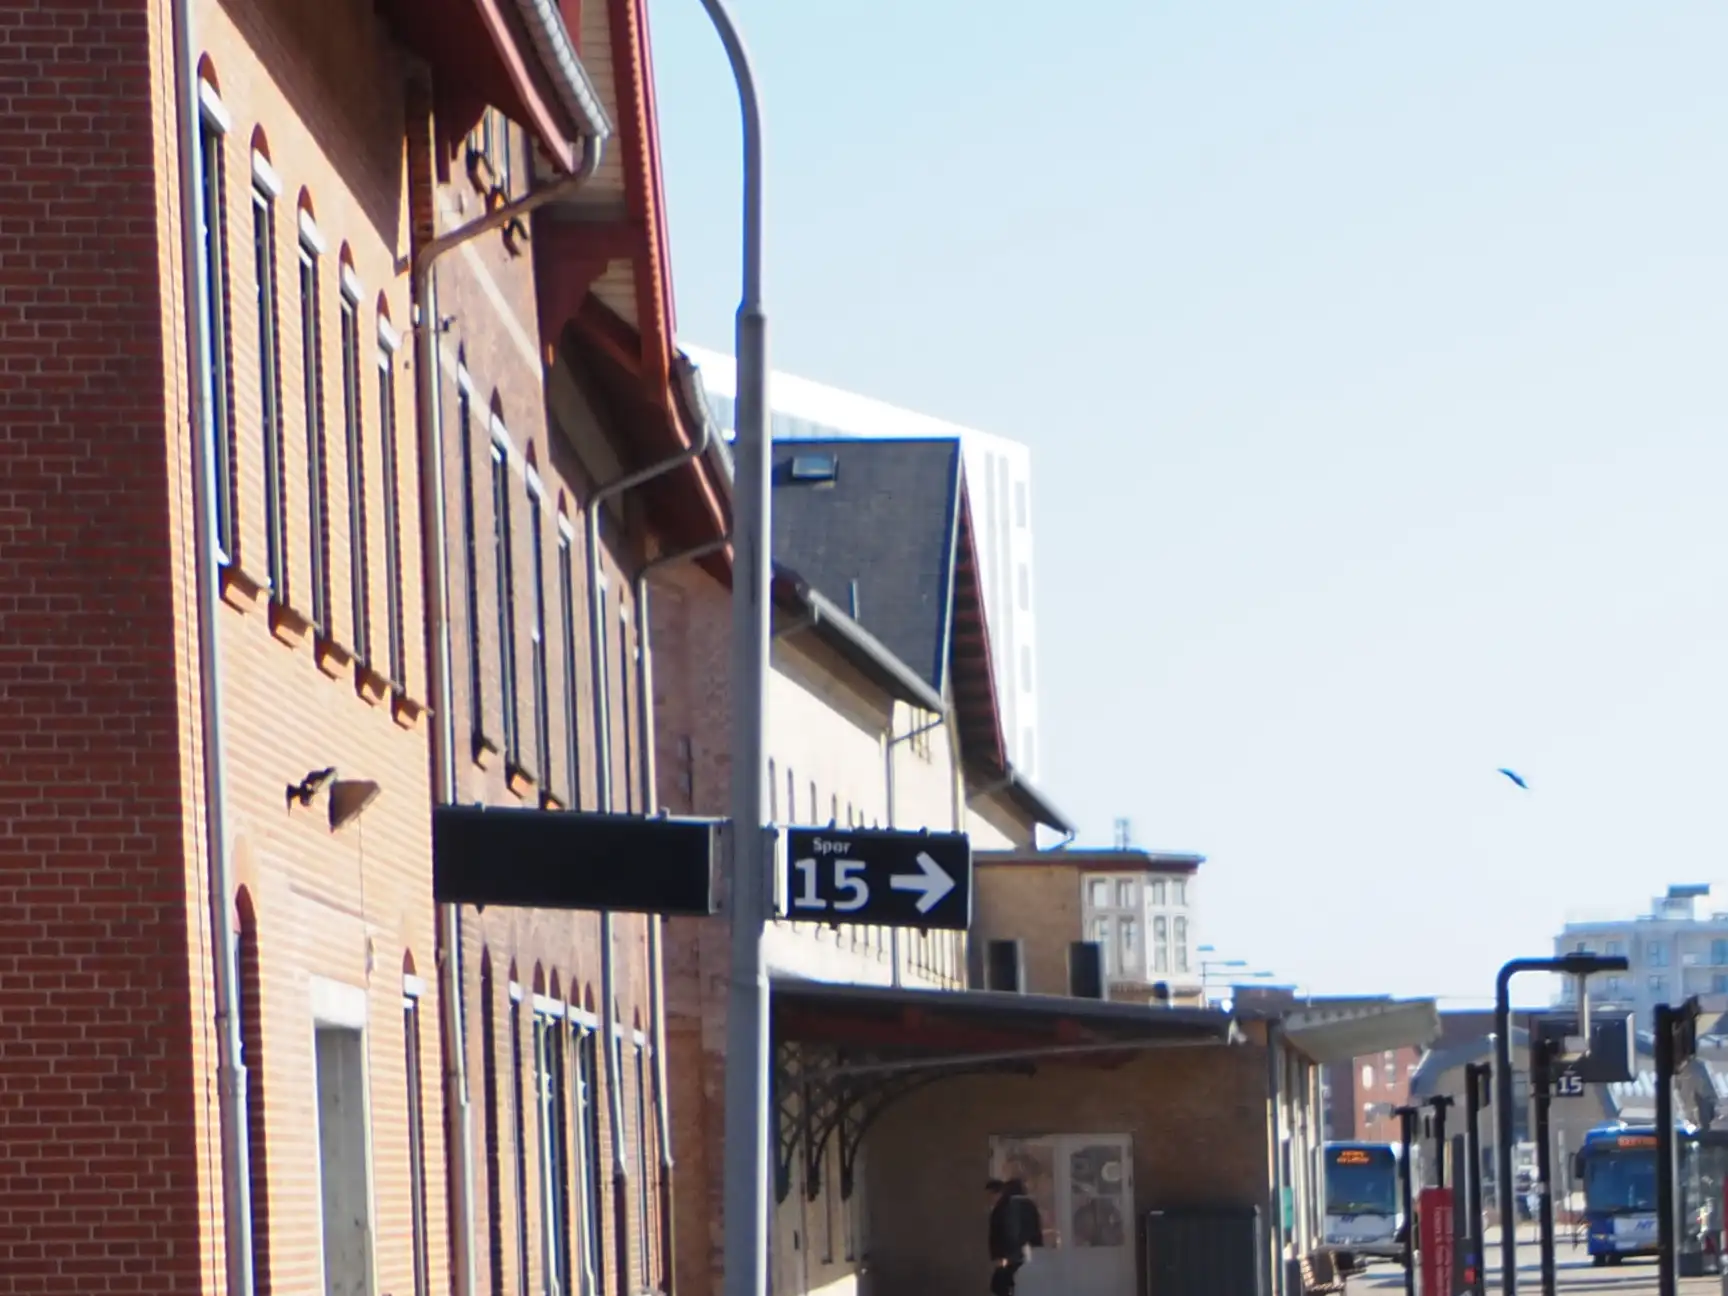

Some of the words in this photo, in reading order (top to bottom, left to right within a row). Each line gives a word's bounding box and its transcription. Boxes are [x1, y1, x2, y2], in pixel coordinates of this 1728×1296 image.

[812, 836, 852, 857] Spor
[793, 857, 870, 912] 15
[1558, 1075, 1583, 1094] 15
